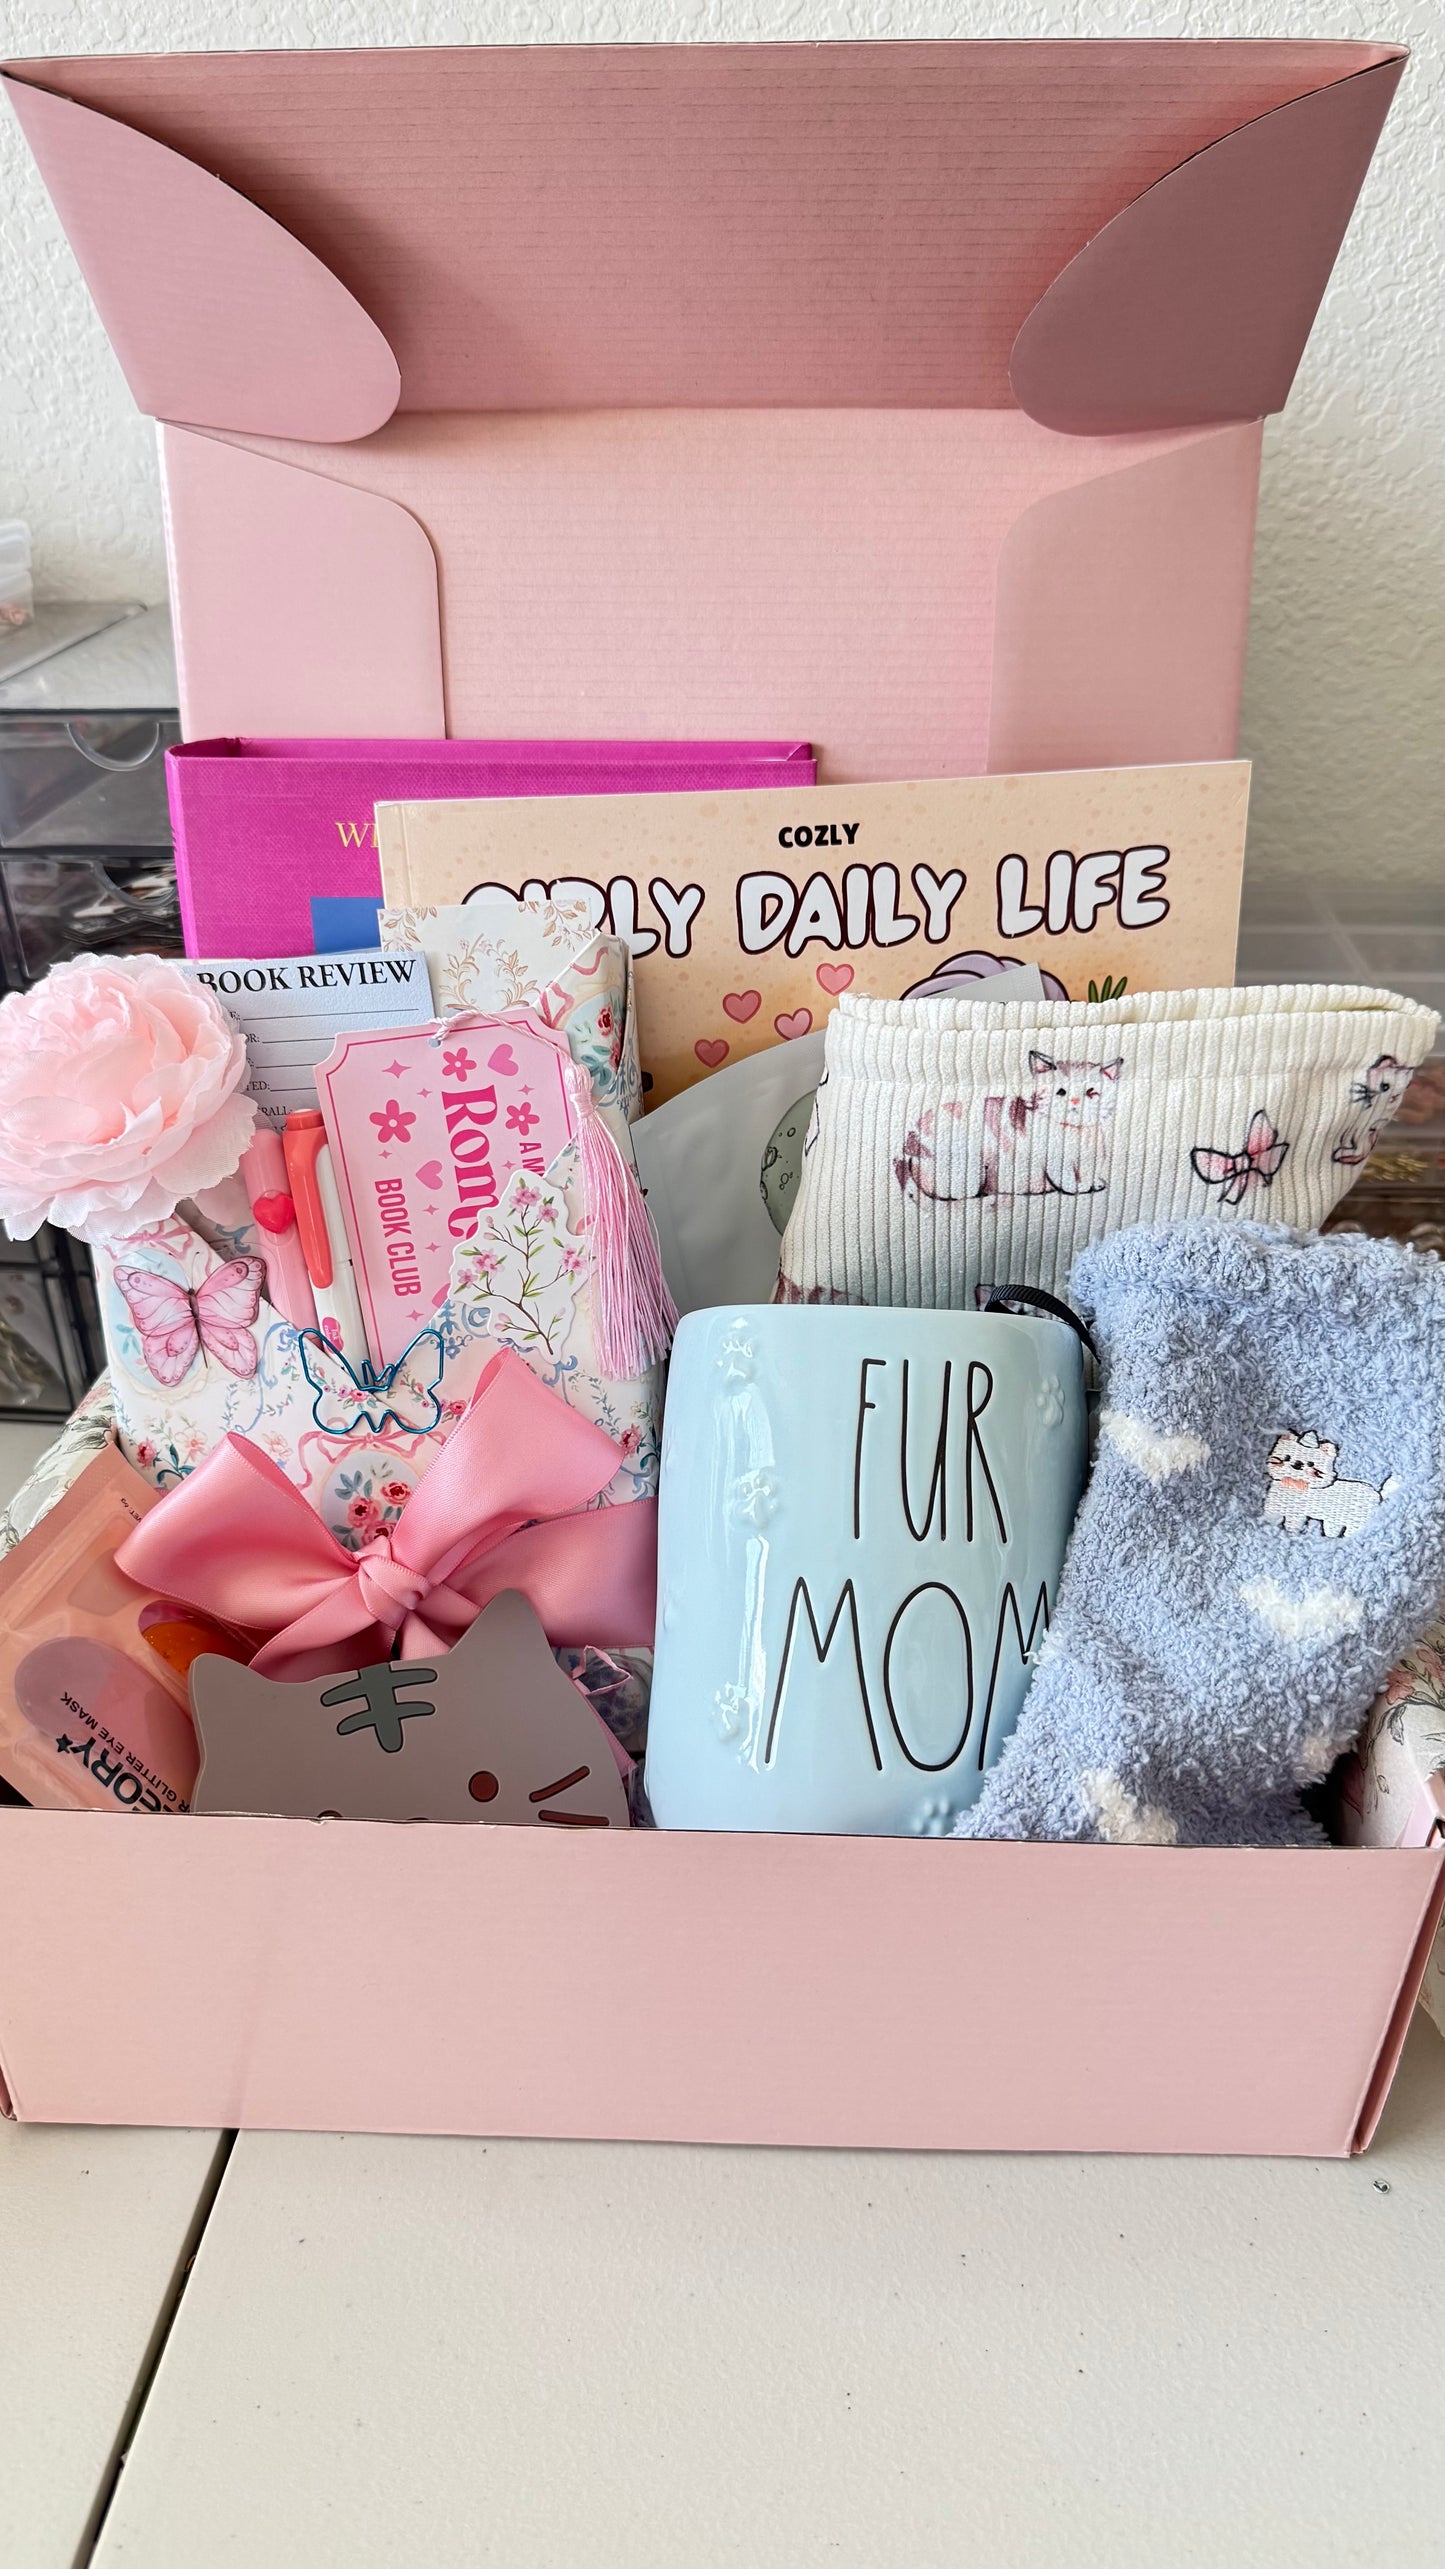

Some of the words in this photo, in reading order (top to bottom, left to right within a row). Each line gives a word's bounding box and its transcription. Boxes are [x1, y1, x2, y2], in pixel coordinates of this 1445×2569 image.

[777, 822, 860, 849] COZLY
[736, 862, 967, 960] DAILY
[996, 845, 1170, 938] LIFE
[196, 967, 293, 994] BOOK
[297, 959, 417, 989] REVIEW
[441, 1085, 500, 1241] Rom
[519, 1143, 542, 1155] A
[374, 1178, 412, 1239] BOOK
[386, 1242, 422, 1297] CLUB
[853, 1358, 1008, 1545] FUR
[764, 1576, 1051, 1772] MOM
[60, 1691, 99, 1730] MASK
[98, 1727, 125, 1755] EYE
[125, 1752, 178, 1803] GLITTER
